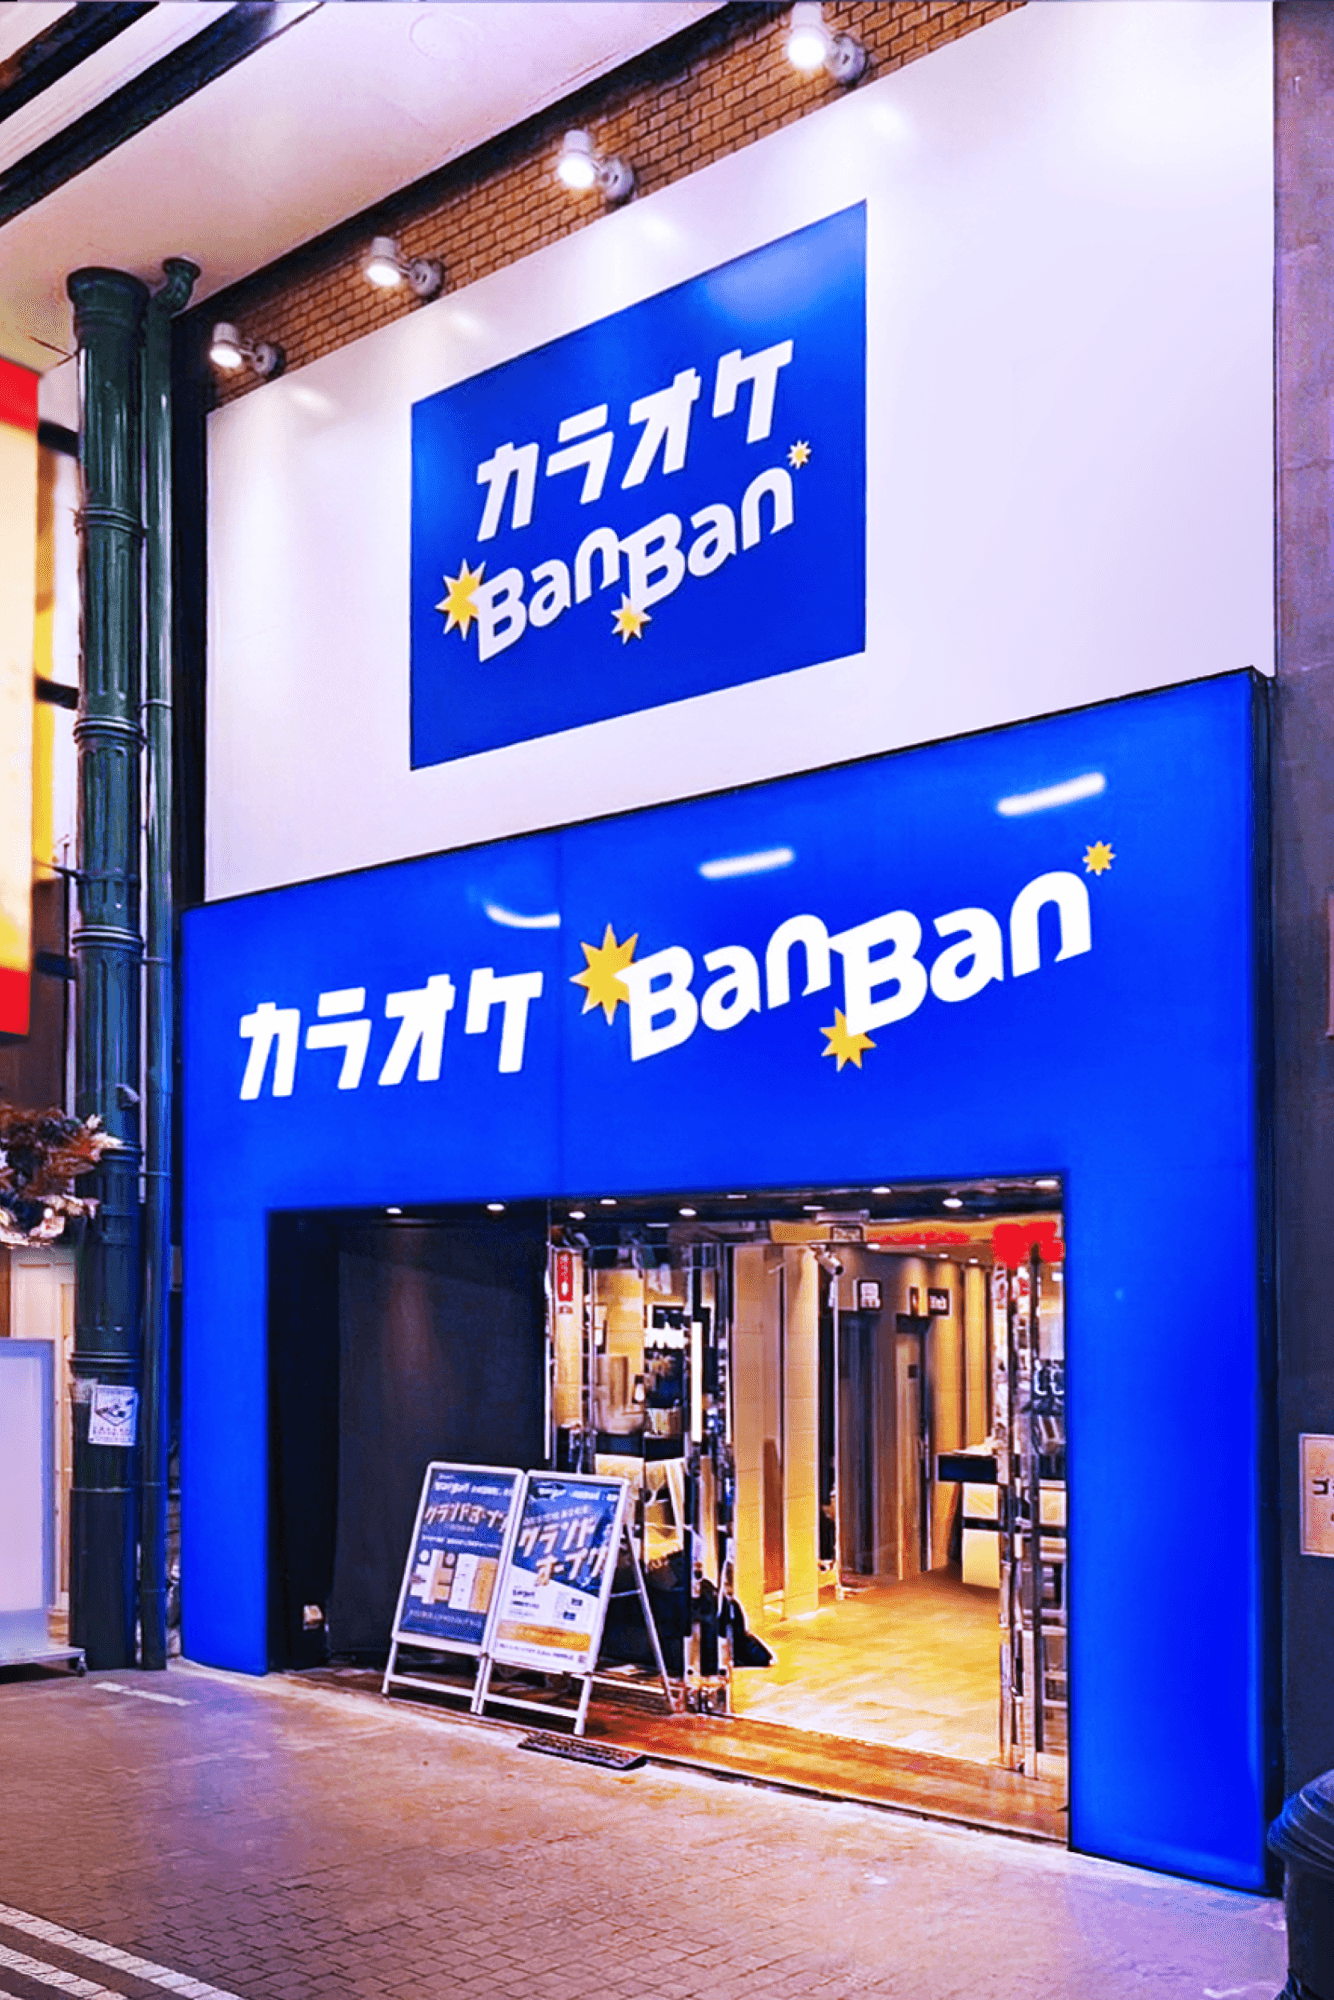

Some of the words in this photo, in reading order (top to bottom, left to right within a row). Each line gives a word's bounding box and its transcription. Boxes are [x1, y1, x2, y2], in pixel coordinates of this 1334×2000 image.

[475, 338, 794, 543] カラオケ
[471, 466, 794, 662] BanBan
[239, 966, 544, 1101] カラオケ
[614, 870, 1092, 1062] BanBan
